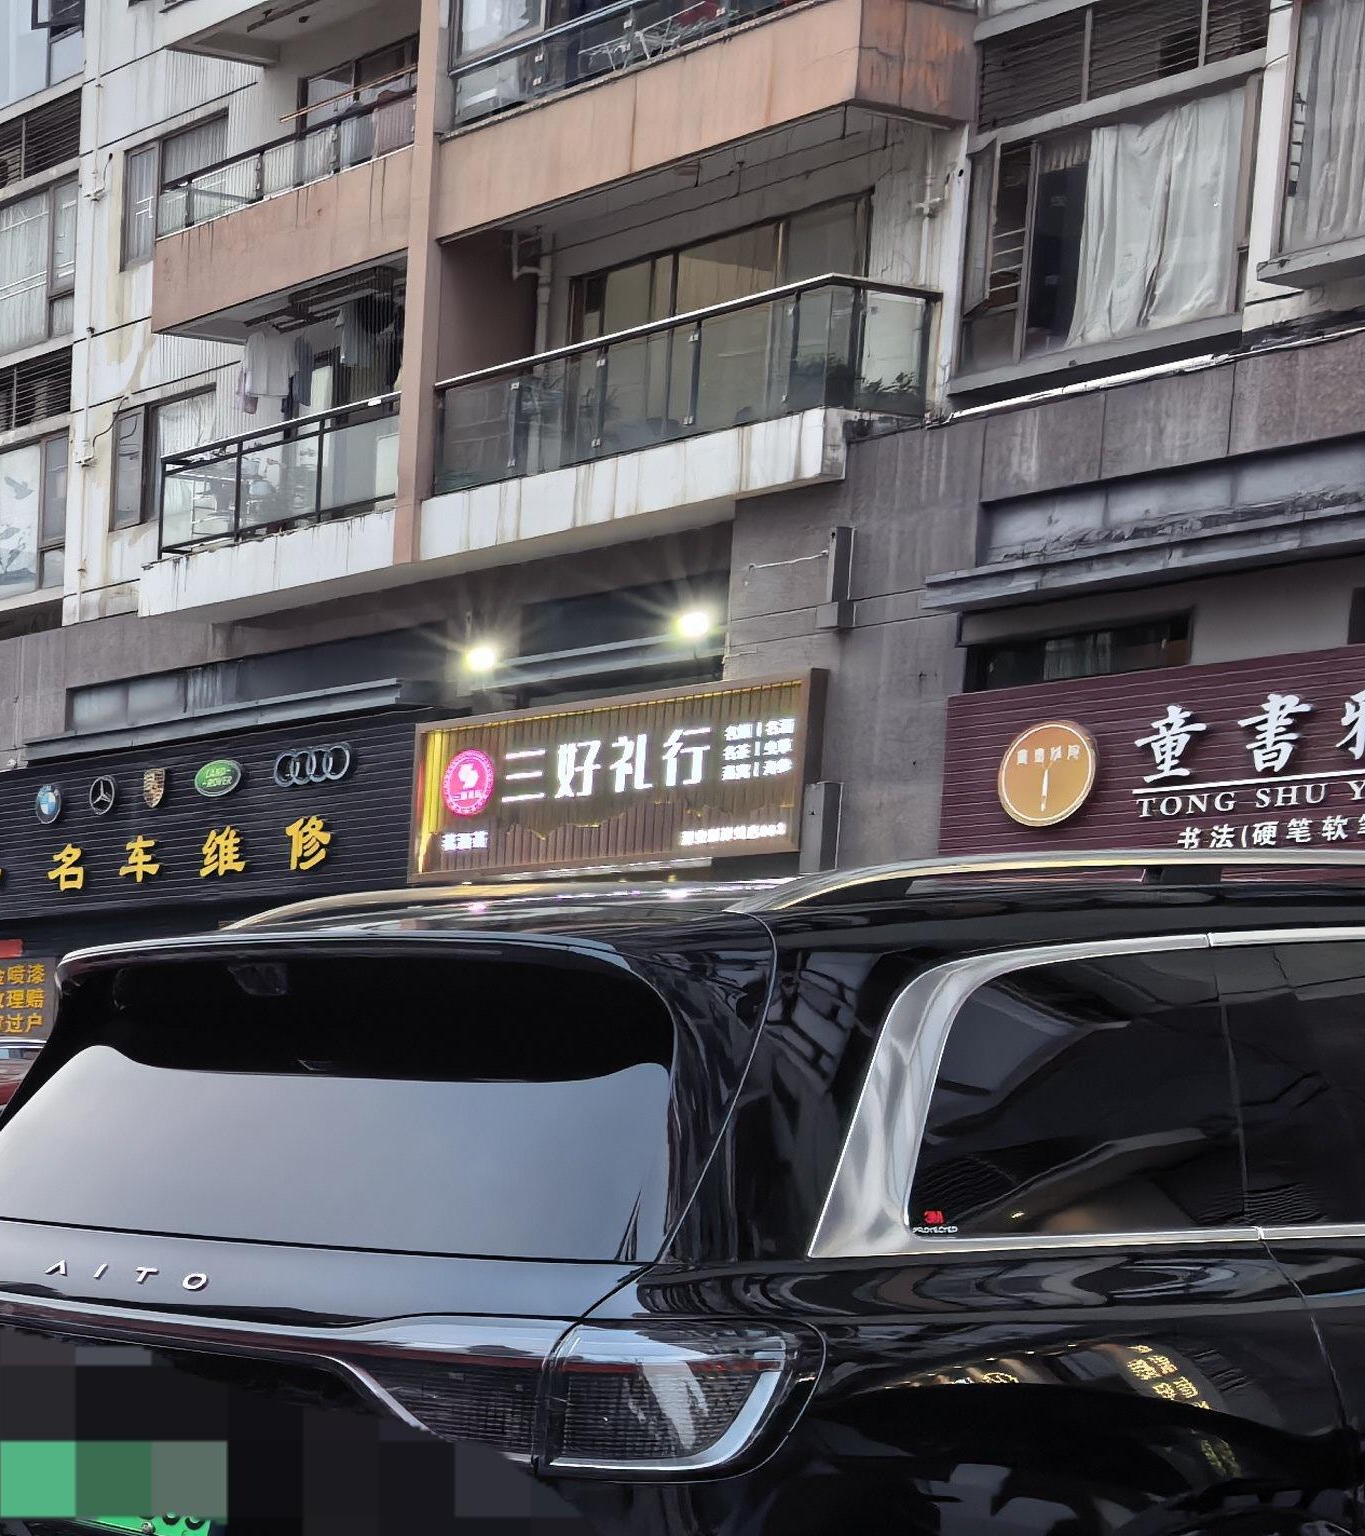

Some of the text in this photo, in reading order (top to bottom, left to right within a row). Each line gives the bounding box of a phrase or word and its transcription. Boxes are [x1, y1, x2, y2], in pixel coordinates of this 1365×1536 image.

[501, 727, 712, 803] 三好礼行
[1135, 793, 1237, 819] TONG
[1255, 783, 1329, 808] SHU
[48, 816, 332, 892] 名车维修
[45, 1259, 209, 1292] AITO
